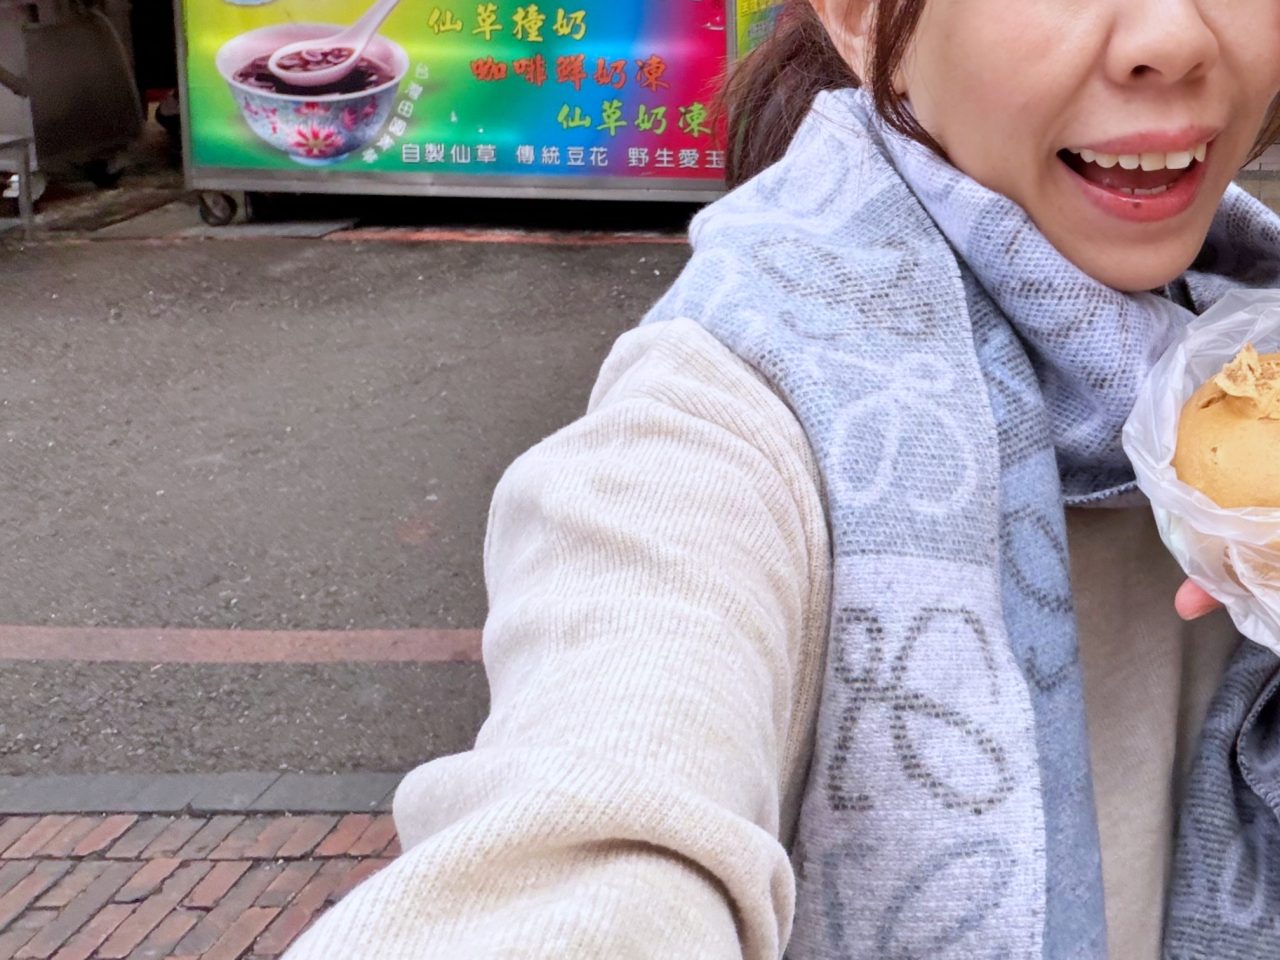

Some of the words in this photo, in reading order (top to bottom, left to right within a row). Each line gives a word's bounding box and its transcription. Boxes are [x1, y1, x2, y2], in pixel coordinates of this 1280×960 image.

[557, 100, 713, 138] 仙草奶凍
[401, 143, 497, 163] 自製仙草
[516, 144, 609, 167] 傳統豆花
